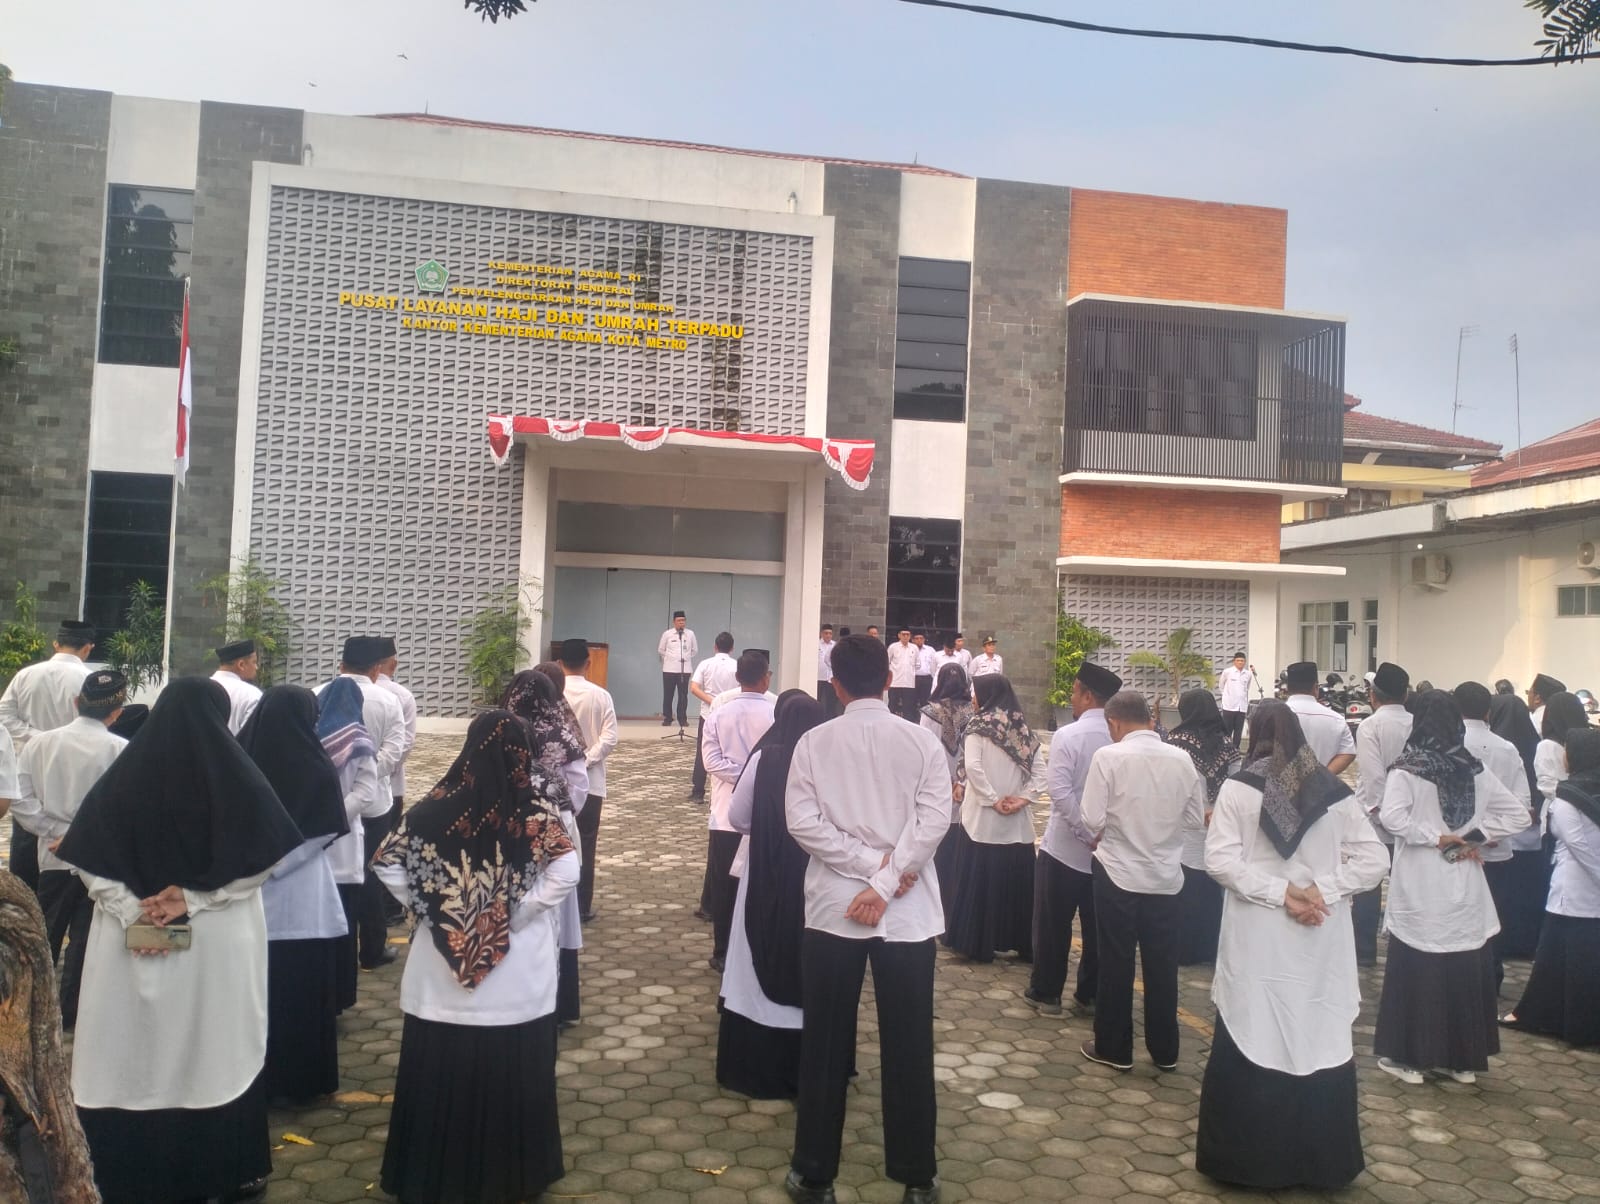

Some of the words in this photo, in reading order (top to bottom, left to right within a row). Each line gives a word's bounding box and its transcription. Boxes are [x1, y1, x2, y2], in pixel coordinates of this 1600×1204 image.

[488, 260, 573, 276] KEMENTERIAN
[579, 269, 621, 281] AGAMA
[628, 273, 641, 282] RI
[452, 286, 572, 304] PENYELENGGARAAN
[575, 297, 602, 306] HAJI
[605, 300, 629, 309] DAN
[633, 302, 674, 312] UMRAH
[496, 276, 572, 290] DIREKTORAT
[575, 283, 633, 296] JENDERAL
[339, 291, 399, 310] PUSAT
[403, 297, 488, 317] LAYANAN
[495, 305, 538, 322] HAJI
[546, 309, 585, 326] DAN
[594, 313, 659, 332] UMRAH
[667, 319, 744, 339] TERPADU
[402, 316, 457, 332] KANTOR
[463, 322, 555, 339] KEMENTERIAN
[559, 329, 602, 343] AGAMA
[607, 334, 640, 347] KOTA
[646, 338, 688, 350] METRO
